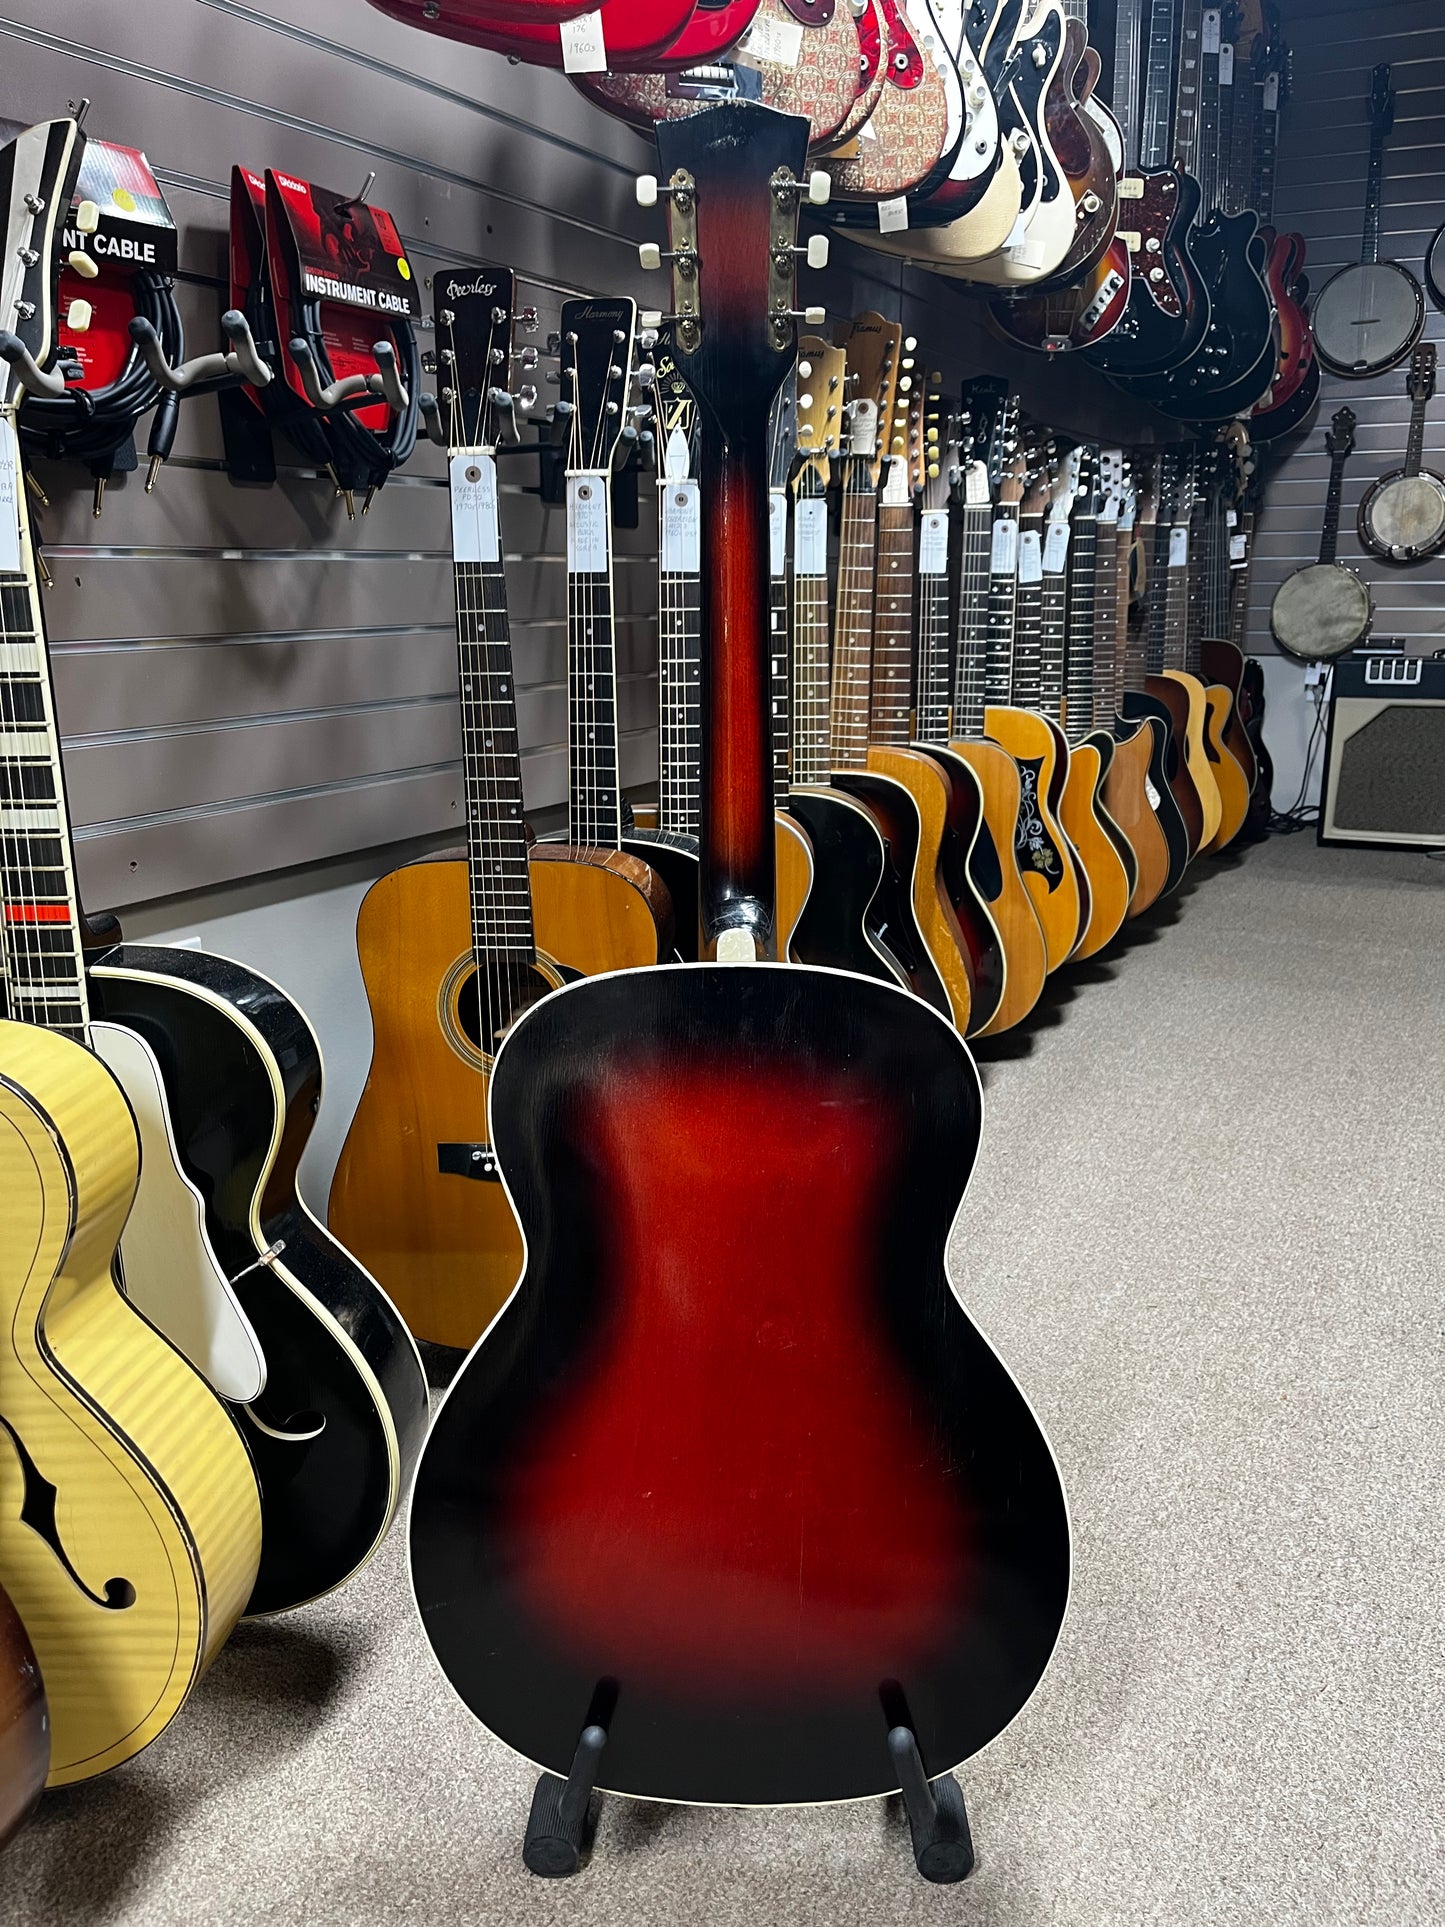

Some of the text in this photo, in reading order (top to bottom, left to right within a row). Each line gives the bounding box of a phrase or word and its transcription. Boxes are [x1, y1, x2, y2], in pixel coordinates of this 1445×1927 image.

[572, 23, 587, 34] 176
[93, 234, 156, 264] CABLE
[305, 273, 411, 315] INSTRUMENT CABLE
[446, 274, 498, 300] Peerless
[574, 305, 625, 321] Harmony
[849, 321, 882, 339] Framus
